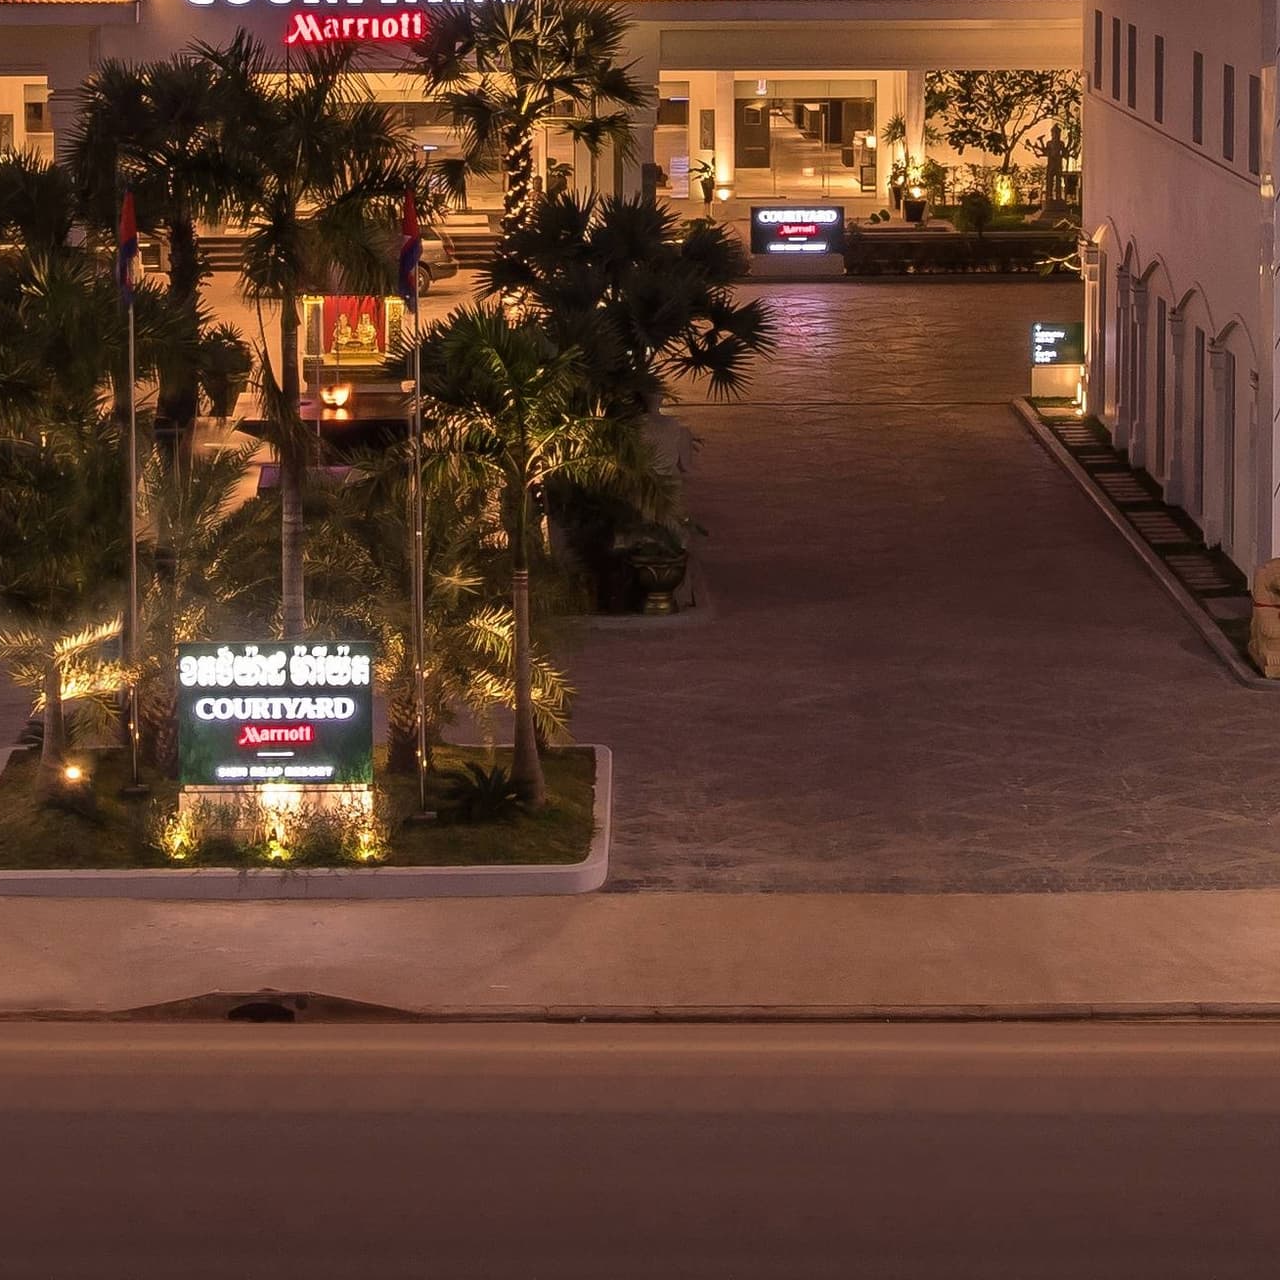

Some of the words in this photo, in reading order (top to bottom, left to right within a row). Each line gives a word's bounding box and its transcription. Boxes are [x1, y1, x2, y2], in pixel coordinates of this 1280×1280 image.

[285, 13, 421, 44] Marriott
[196, 697, 355, 720] COURTYARD
[239, 726, 312, 744] Marriott
